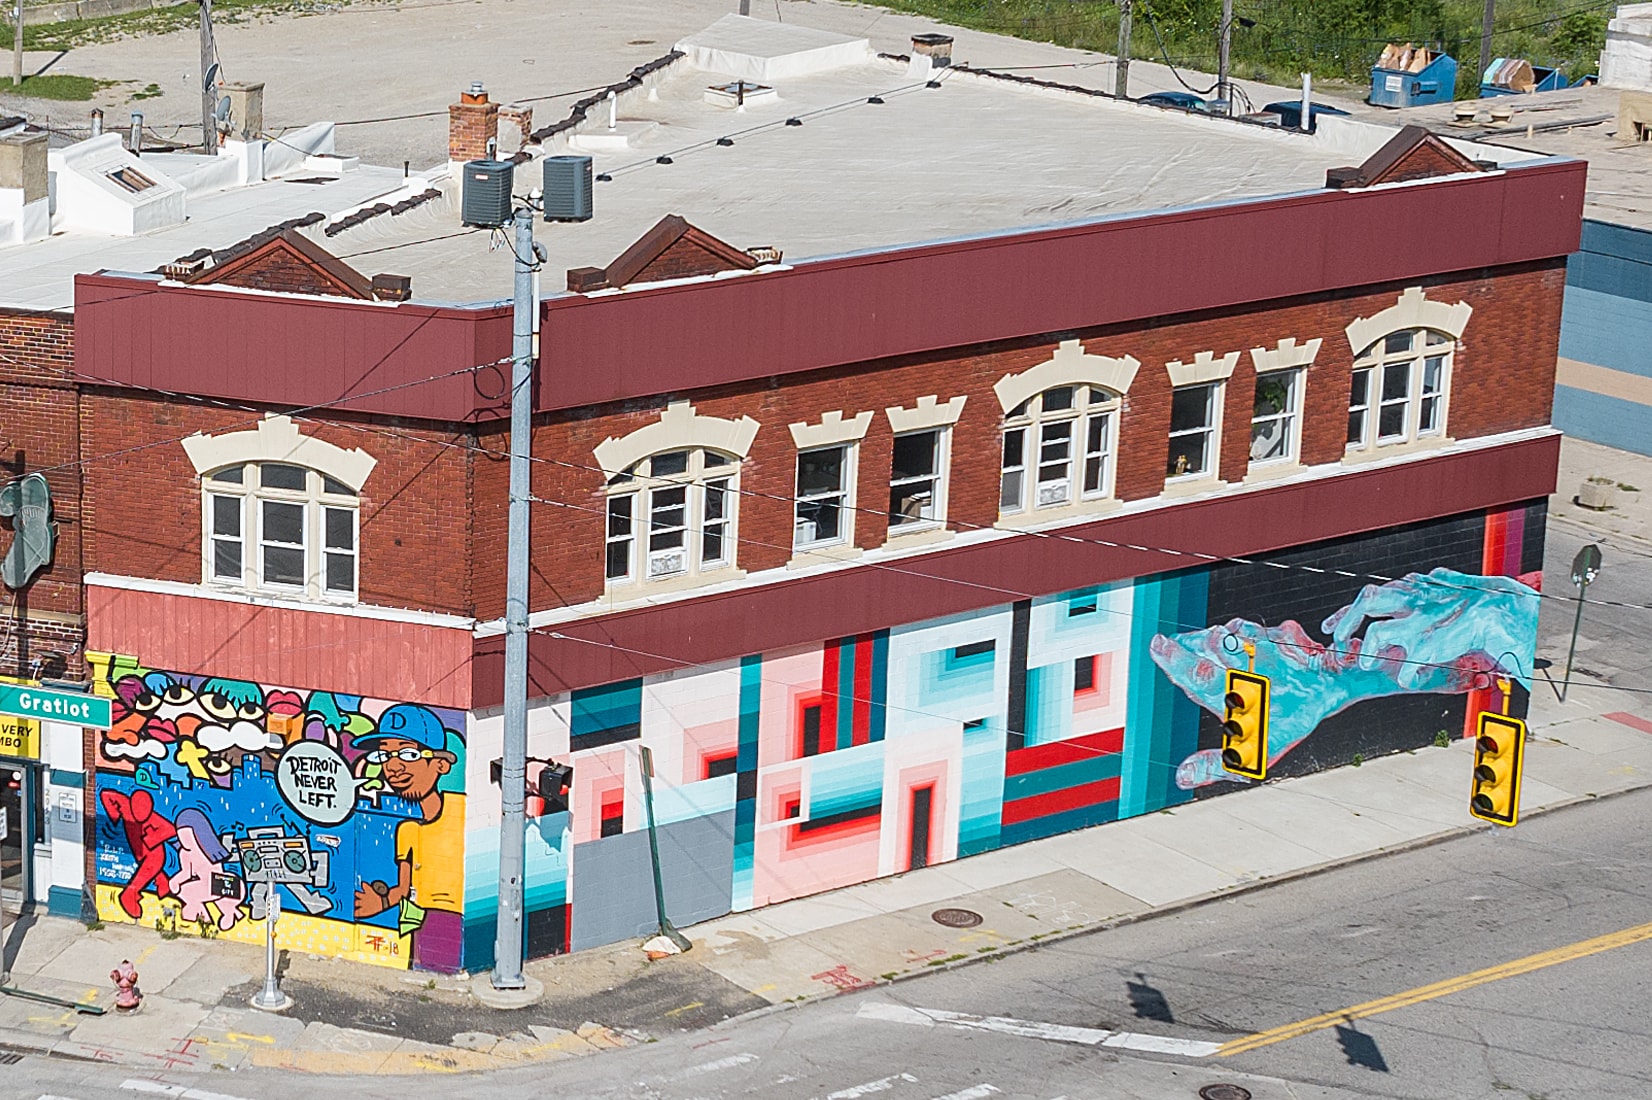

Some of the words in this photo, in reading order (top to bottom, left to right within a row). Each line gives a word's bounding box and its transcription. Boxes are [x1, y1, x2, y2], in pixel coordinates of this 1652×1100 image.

[19, 692, 90, 719] Gratiot
[389, 711, 407, 730] D
[1, 723, 33, 738] VERY
[294, 773, 337, 792] NEVER
[299, 790, 337, 809] LEFT.
